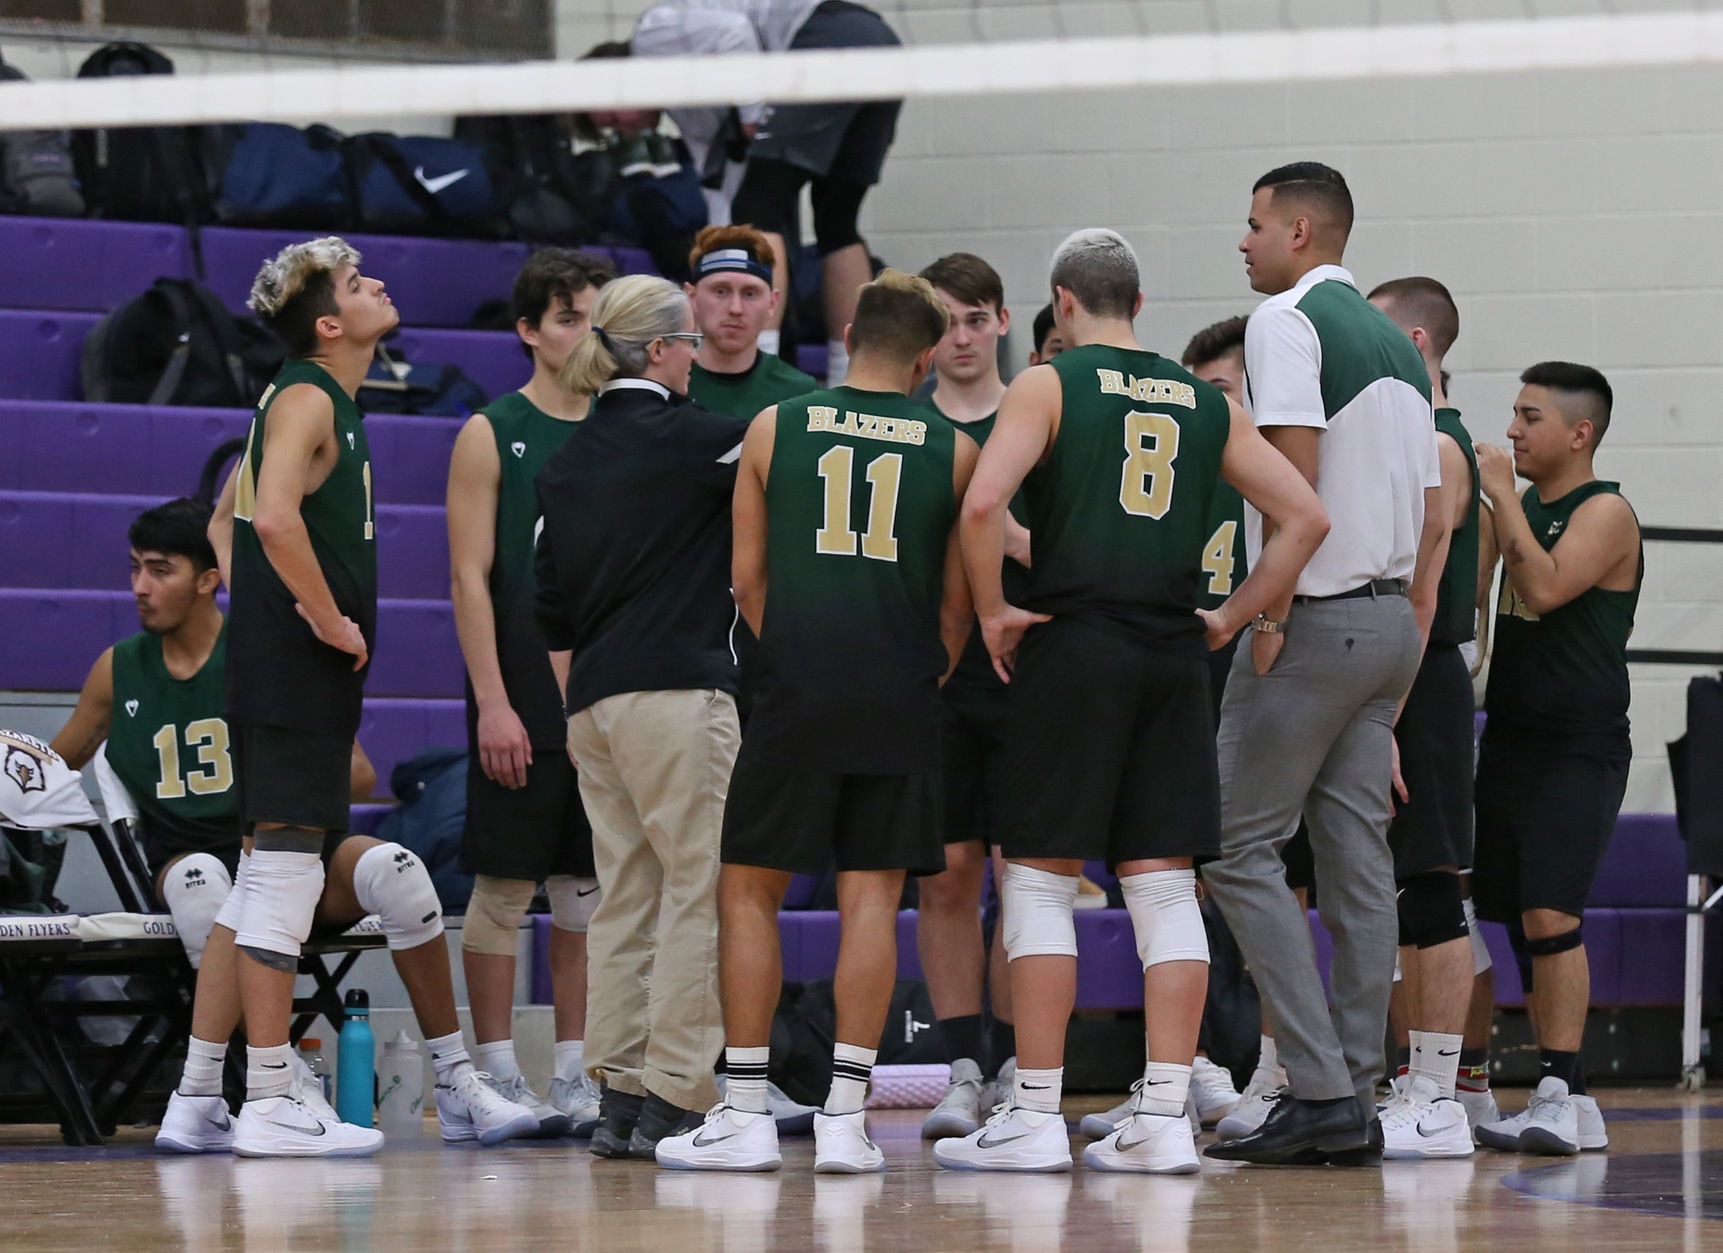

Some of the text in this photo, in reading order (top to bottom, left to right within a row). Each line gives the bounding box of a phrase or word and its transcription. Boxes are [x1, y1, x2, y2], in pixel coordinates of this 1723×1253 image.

[1096, 368, 1197, 410] BLAZERS
[807, 406, 927, 446] BLAZERS
[1119, 409, 1180, 521] 8
[816, 445, 903, 562] 11
[153, 717, 235, 799] 13
[28, 923, 71, 937] FLYERS
